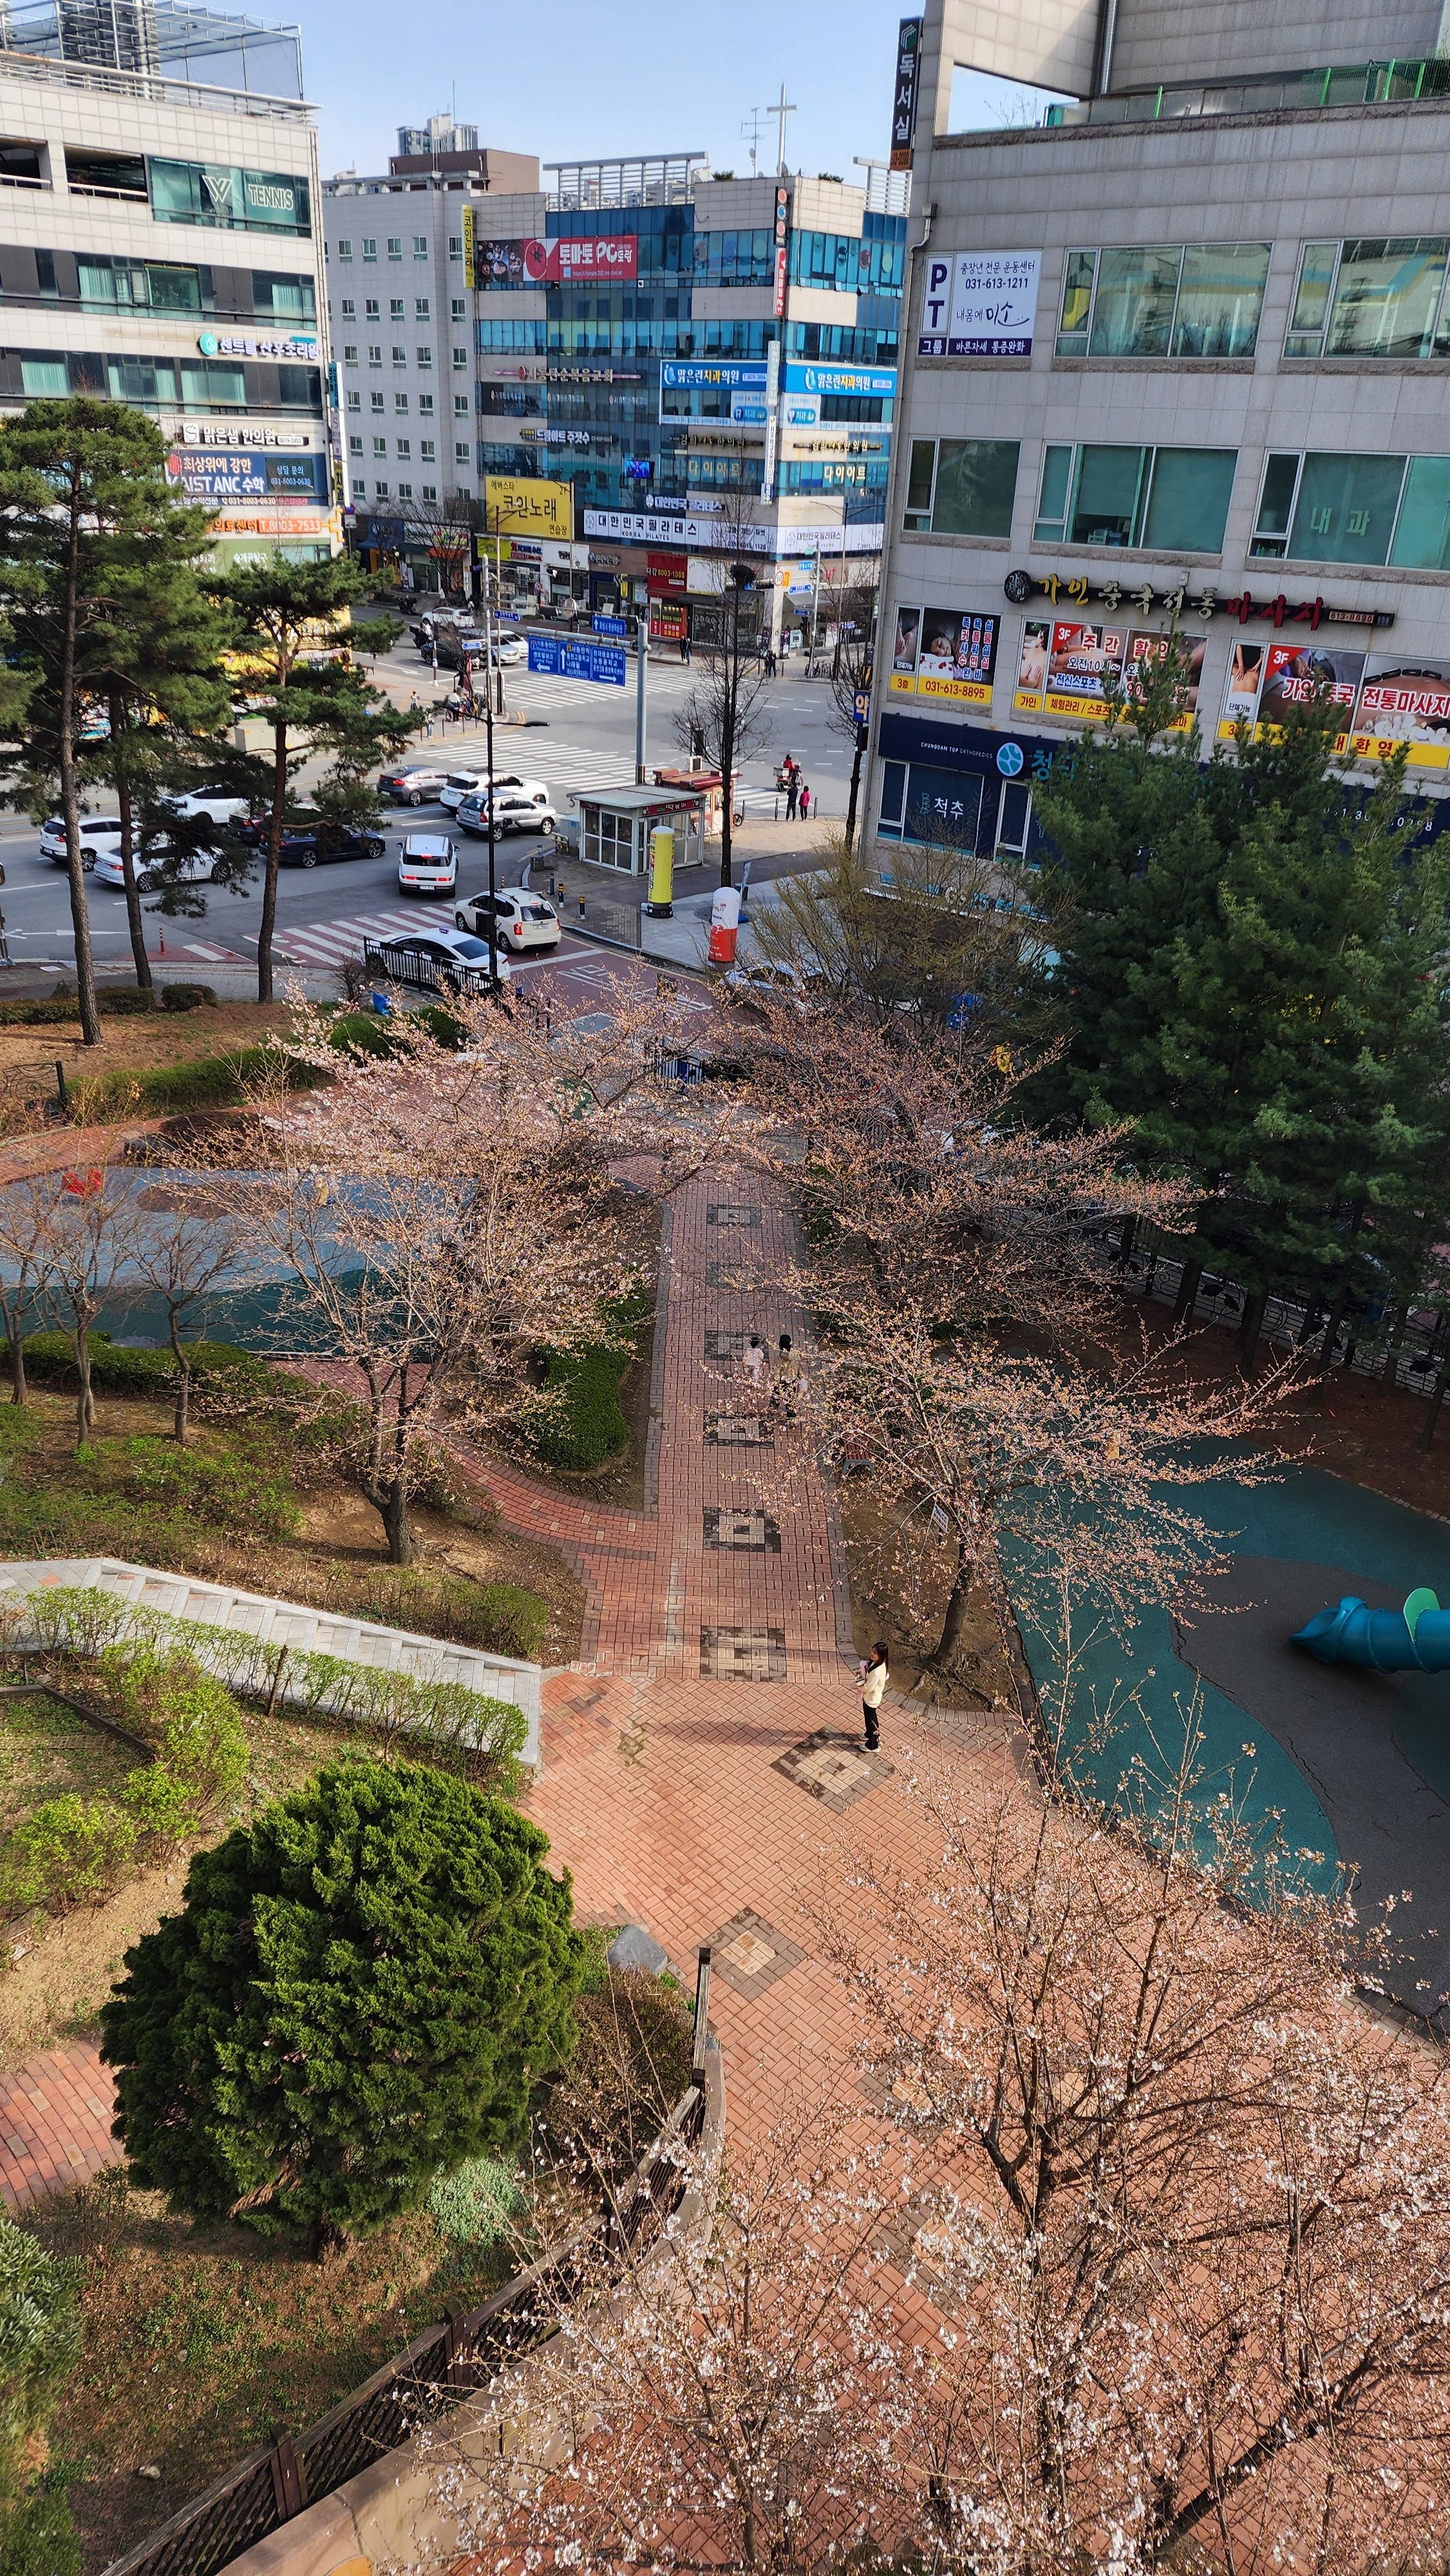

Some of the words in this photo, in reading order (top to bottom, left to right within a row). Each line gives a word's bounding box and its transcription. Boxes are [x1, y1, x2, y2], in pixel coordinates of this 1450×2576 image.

[896, 53, 914, 140] 독서실
[249, 184, 293, 210] TENNIS
[464, 216, 473, 269] 코인노래
[559, 243, 593, 264] 토마토
[596, 242, 617, 264] PC
[961, 262, 983, 275] 중장년
[986, 261, 1001, 274] 전문
[1003, 260, 1035, 274] 운동센터
[965, 278, 1028, 289] 031-613-1211
[928, 264, 947, 328] PT
[956, 308, 983, 323] 내몸에
[986, 301, 1030, 327] 미소
[220, 336, 257, 355] 센트럴
[922, 339, 942, 354] 그룹
[956, 340, 988, 354] 바른자세
[992, 340, 1025, 354] 통증완화
[529, 366, 613, 383] 서동탄순복음교회
[677, 369, 740, 384] 맑은린치과의원
[817, 373, 870, 391] 맑은린치과의원
[203, 426, 239, 444] 맑은샘
[242, 428, 276, 446] 한의원
[537, 429, 567, 443] 드림아트
[567, 430, 590, 444] 주짓수
[184, 456, 227, 474] 최상위에
[230, 457, 252, 474] 강한
[276, 465, 289, 475] 상담
[291, 465, 304, 475] 문의
[824, 466, 866, 483] 다이어트
[214, 477, 241, 493] ANC
[242, 477, 266, 493] 수학
[491, 480, 514, 491] 에버스타
[504, 495, 556, 522] 코인노래
[655, 495, 687, 511] 대한민국
[689, 498, 722, 513] 필라테스
[1310, 507, 1371, 536] 내과
[549, 524, 567, 536] 연습장
[1038, 573, 1089, 606] 가인
[1225, 591, 1324, 631] 마사지
[1330, 612, 1373, 623] 613-8895
[962, 616, 993, 632] 족욕실
[960, 629, 992, 644] 커플룸
[1058, 627, 1071, 640] 3F
[959, 642, 990, 657] 샤워실
[1082, 633, 1119, 656] 주간
[958, 654, 989, 669] 수면실
[1272, 650, 1288, 665] 3F
[962, 667, 983, 681] 완비
[1056, 674, 1097, 690] 전신스포츠
[897, 678, 909, 689] 3층
[925, 680, 985, 699] 031-613-8895
[1020, 696, 1037, 708] 가인
[1050, 697, 1080, 713] 체형관리
[1282, 677, 1315, 703] 가인
[1361, 685, 1450, 719] 전통마사지
[855, 694, 869, 721] 약
[1229, 702, 1251, 714] 단체가능
[921, 741, 948, 752] CHUNGDAM
[959, 748, 993, 759] ORTHOPEDICS
[934, 797, 964, 820] 척추
